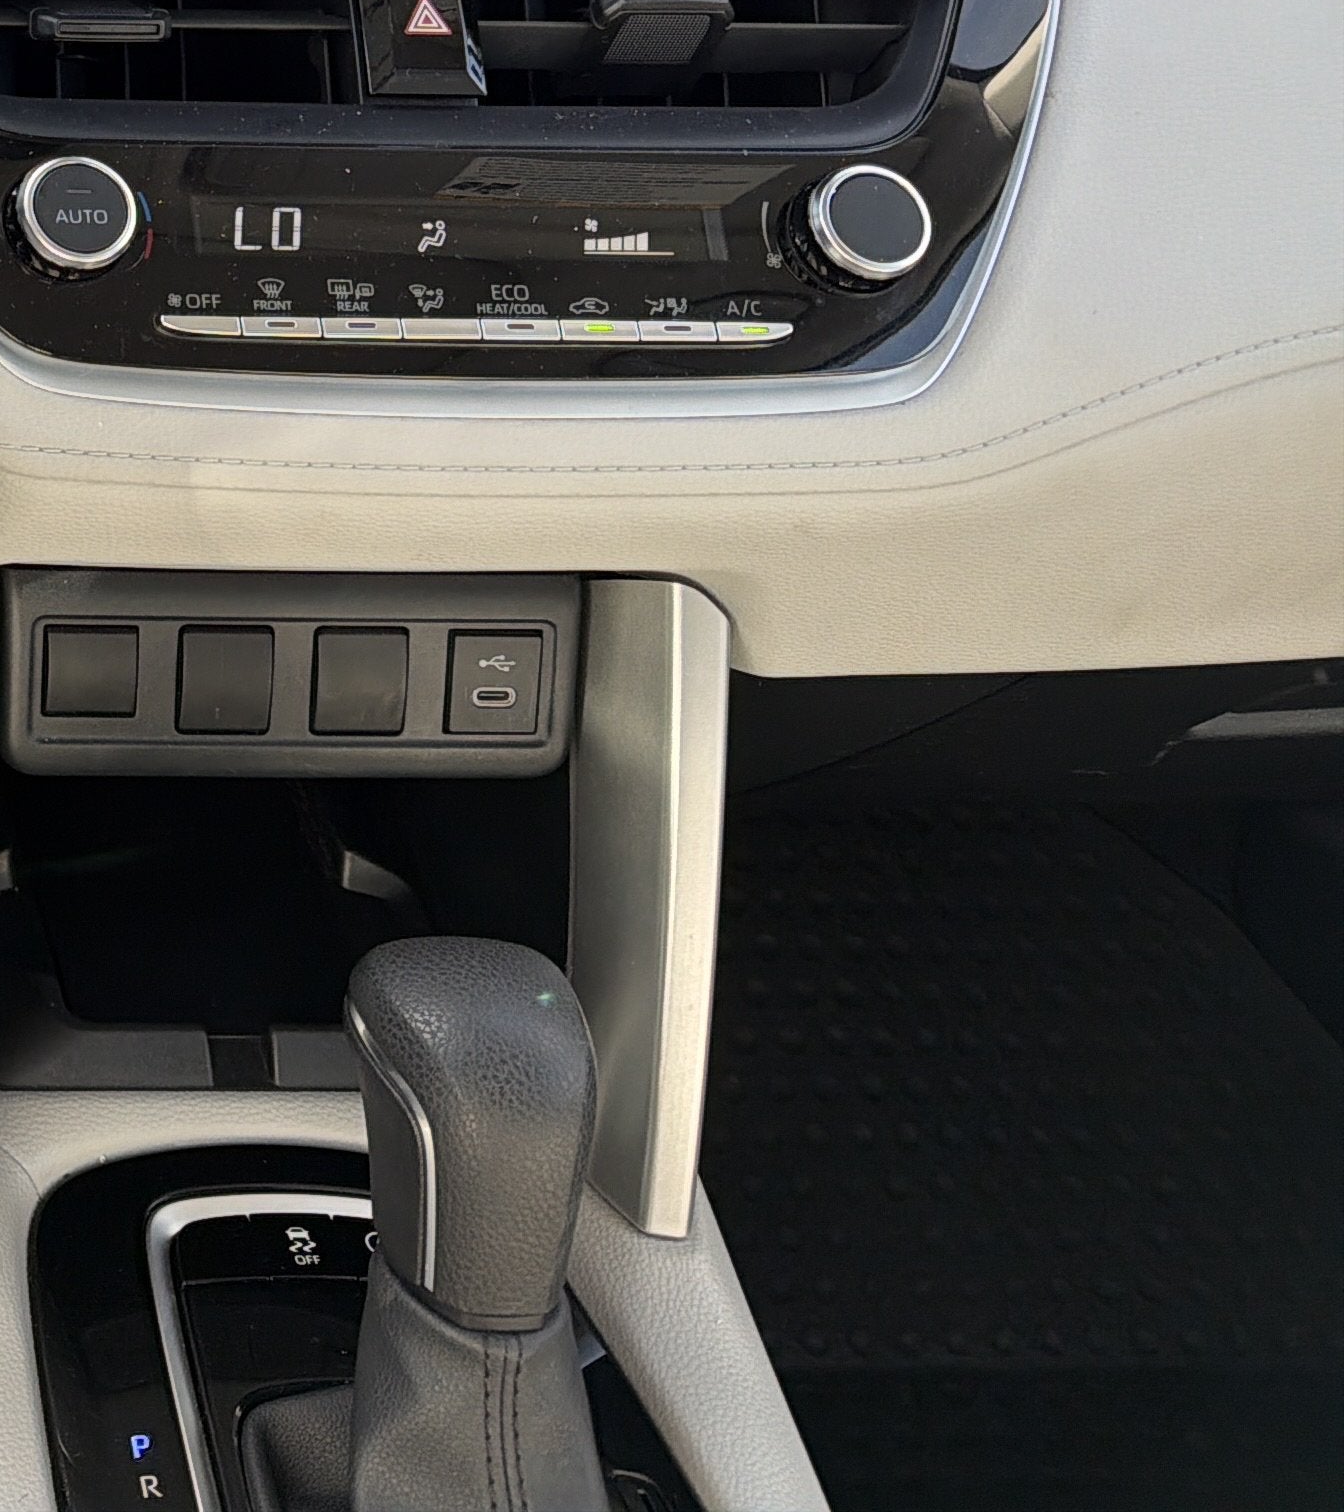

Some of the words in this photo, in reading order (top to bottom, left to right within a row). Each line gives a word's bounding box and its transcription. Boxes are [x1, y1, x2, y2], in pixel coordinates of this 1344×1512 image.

[55, 208, 108, 225] AUTO
[186, 293, 222, 308] OFF
[491, 285, 529, 301] ECO
[253, 299, 292, 311] FRONT
[337, 300, 369, 312] REAR
[477, 302, 548, 316] HEAT/COOL
[727, 299, 762, 318] A/C
[294, 1255, 320, 1265] OFF
[131, 1434, 150, 1459] P
[139, 1475, 164, 1499] R
